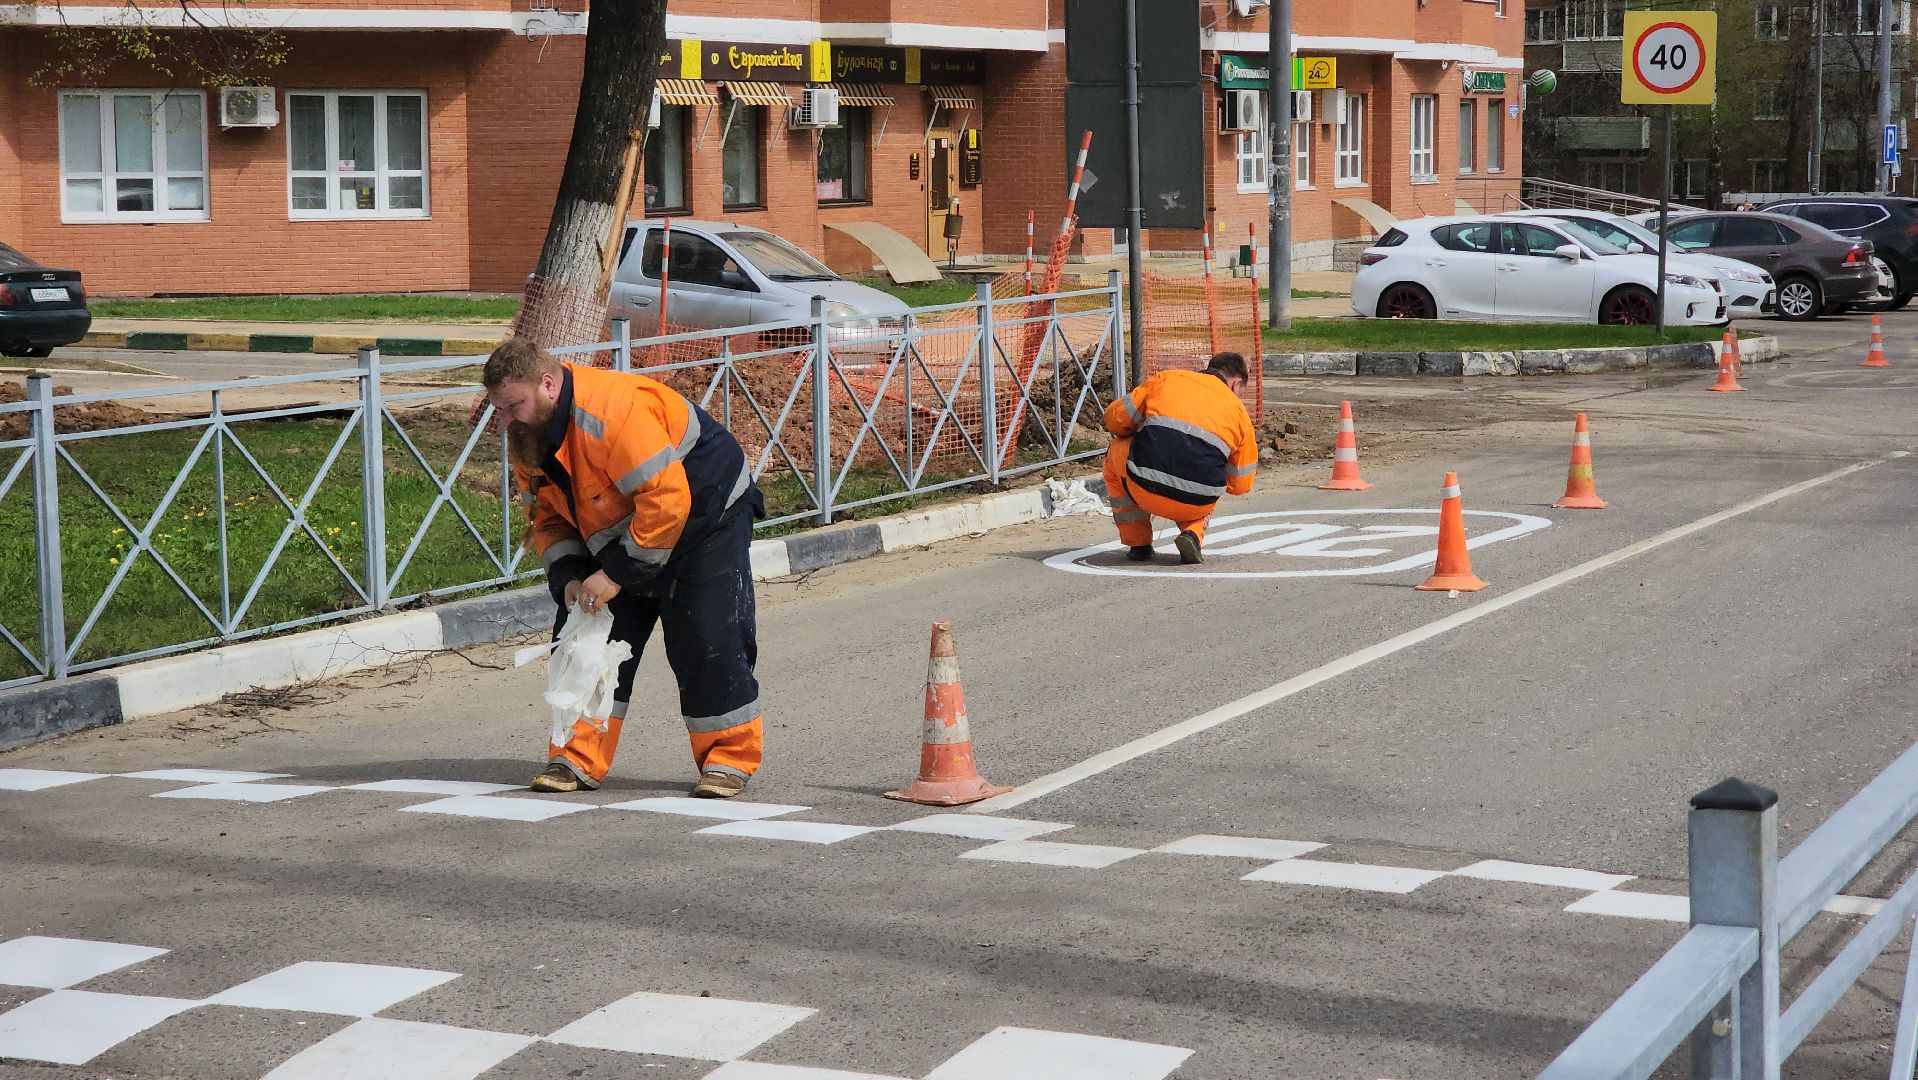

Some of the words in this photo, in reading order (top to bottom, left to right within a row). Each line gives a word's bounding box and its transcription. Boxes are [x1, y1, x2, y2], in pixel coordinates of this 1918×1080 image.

[728, 45, 803, 79] Европейская
[1649, 44, 1687, 71] 40
[1308, 70, 1321, 79] 24
[1886, 129, 1895, 159] P
